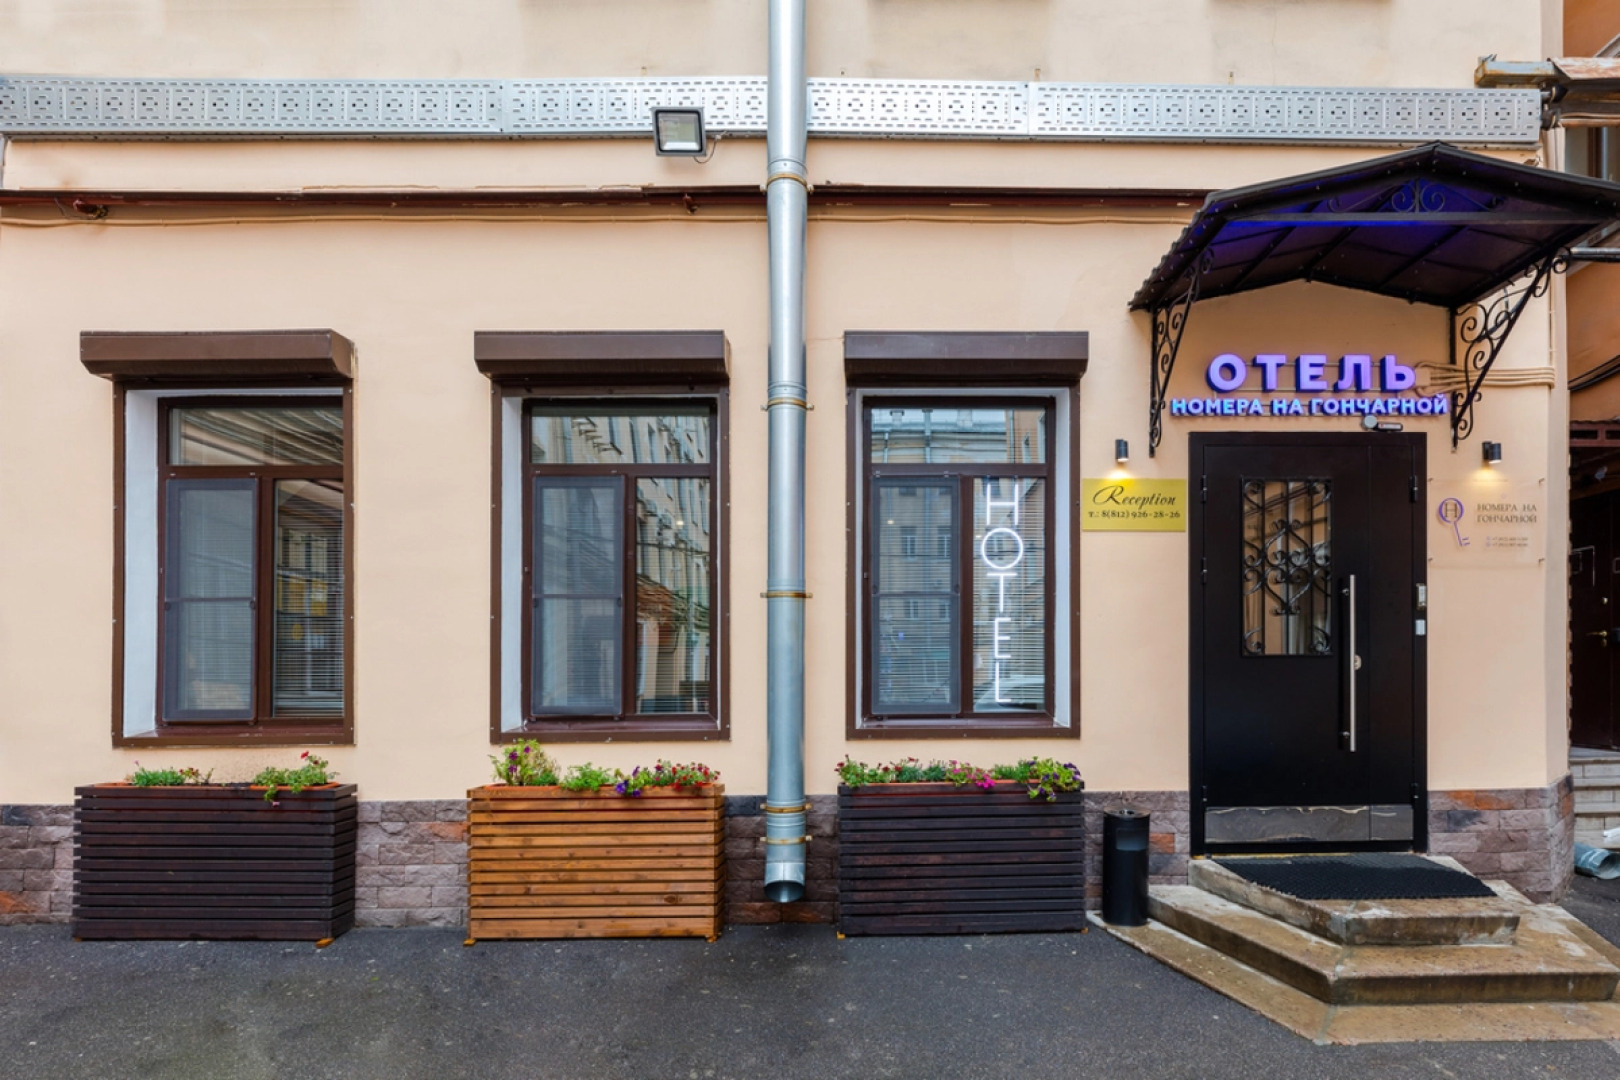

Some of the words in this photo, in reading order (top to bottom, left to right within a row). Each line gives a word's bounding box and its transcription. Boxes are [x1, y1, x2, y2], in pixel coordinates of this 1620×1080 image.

[1206, 354, 1415, 393] ОТЕЛЬ
[1171, 398, 1263, 416] НОМЕРА
[1271, 398, 1304, 416] НА
[1309, 394, 1448, 416] ГОНЧАРНОЙ
[1092, 485, 1176, 510] Reception
[1476, 503, 1518, 512] НОМЕРА
[1522, 503, 1537, 512] НА
[1476, 513, 1537, 523] ГОНЧАРНОЙ
[981, 483, 1024, 703] HOTEL
